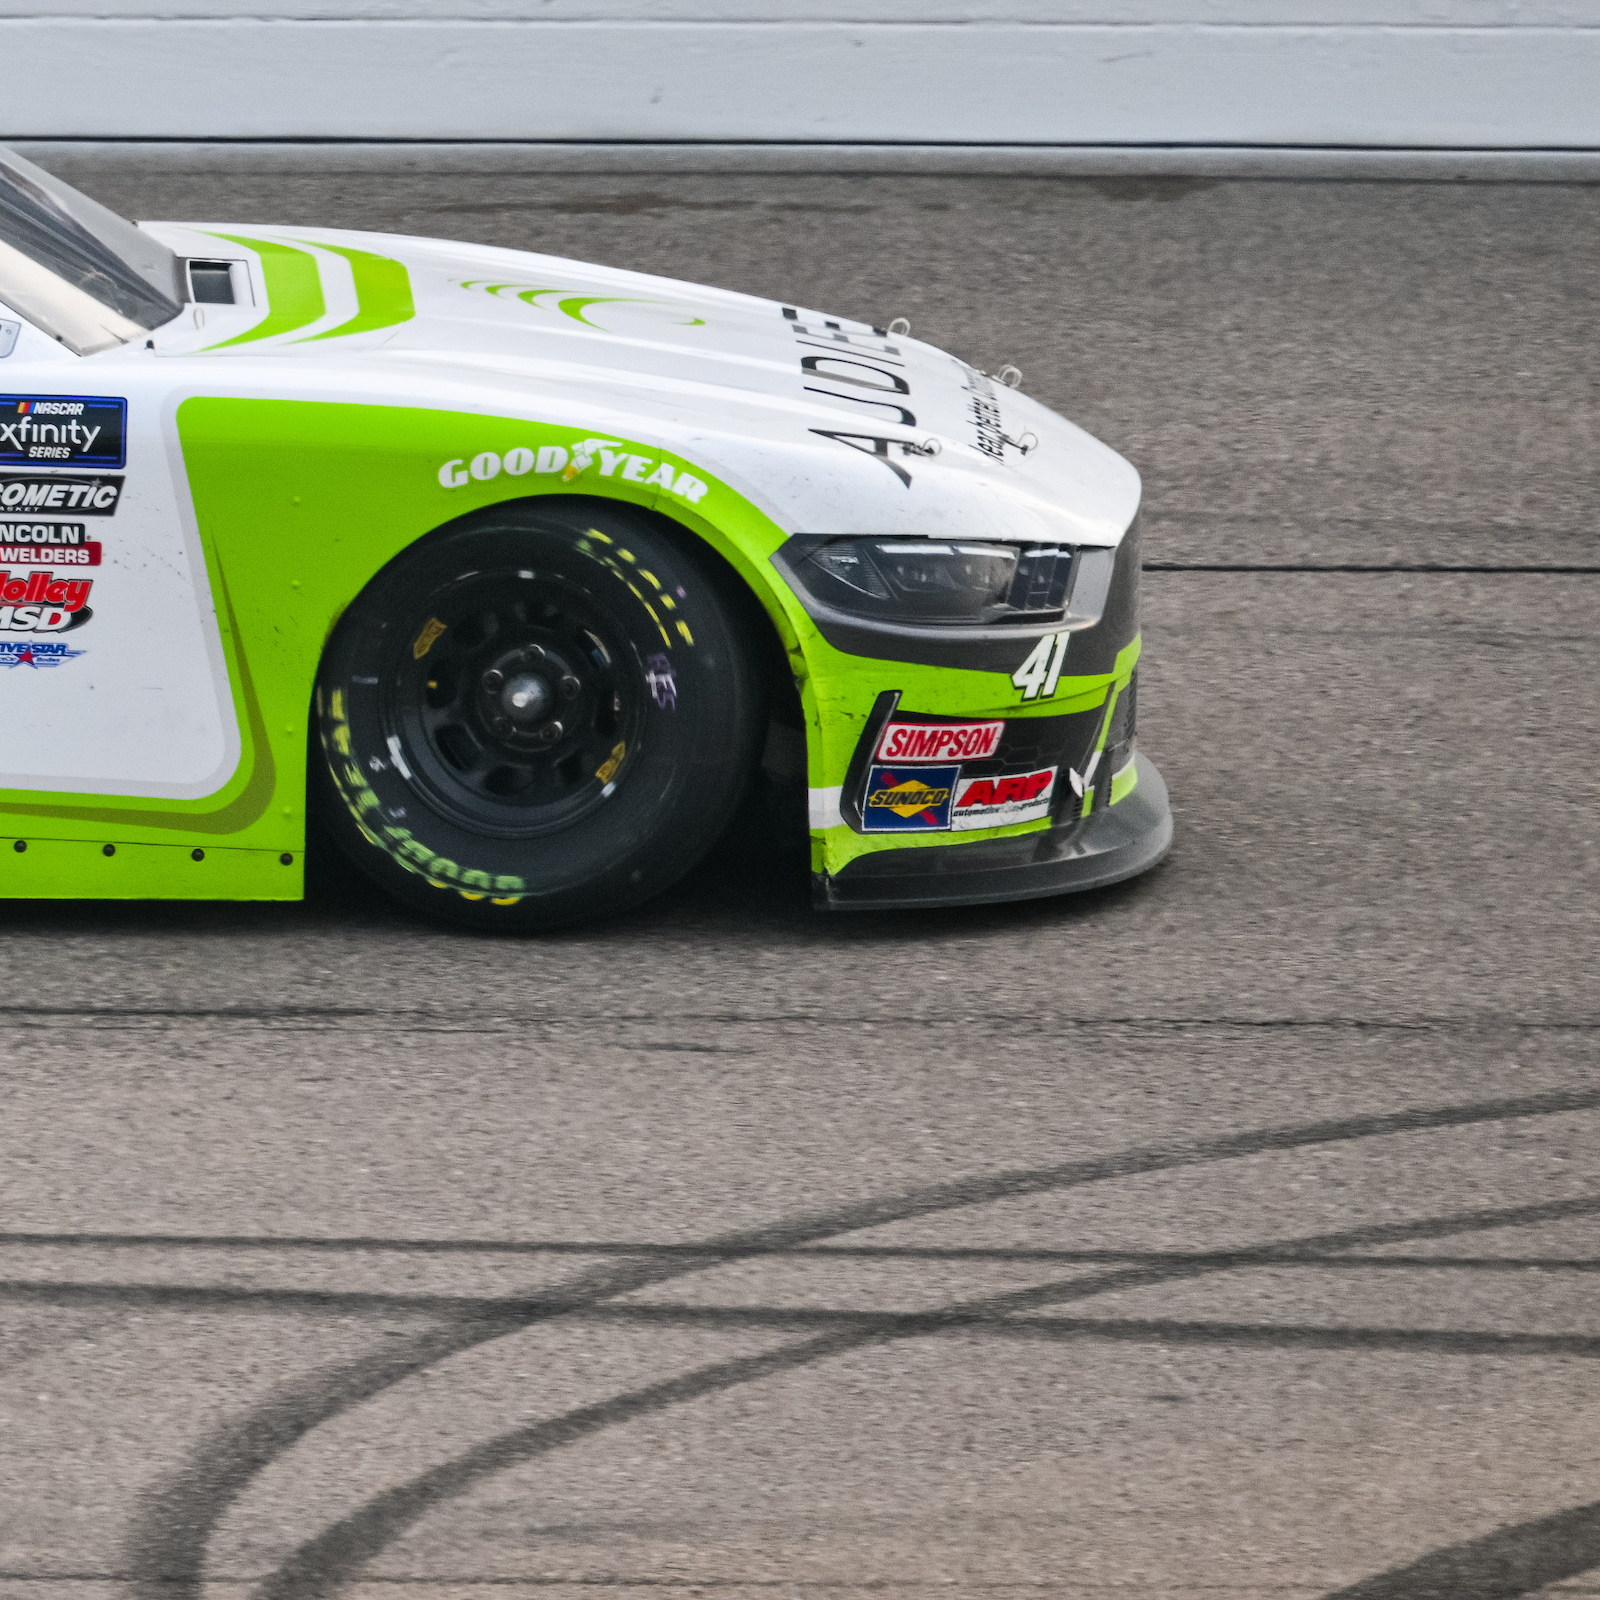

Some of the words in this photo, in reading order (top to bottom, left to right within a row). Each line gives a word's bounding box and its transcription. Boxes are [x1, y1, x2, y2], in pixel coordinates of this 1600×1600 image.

[33, 402, 85, 415] NASCAR
[0, 415, 102, 452] xfinity
[28, 446, 72, 459] SERIES
[0, 547, 90, 564] WELDERS
[31, 643, 69, 655] STAR
[1010, 630, 1071, 702] 41
[885, 725, 999, 758] SIMPSON
[870, 789, 950, 806] SUNOCO
[956, 771, 1053, 807] ARP
